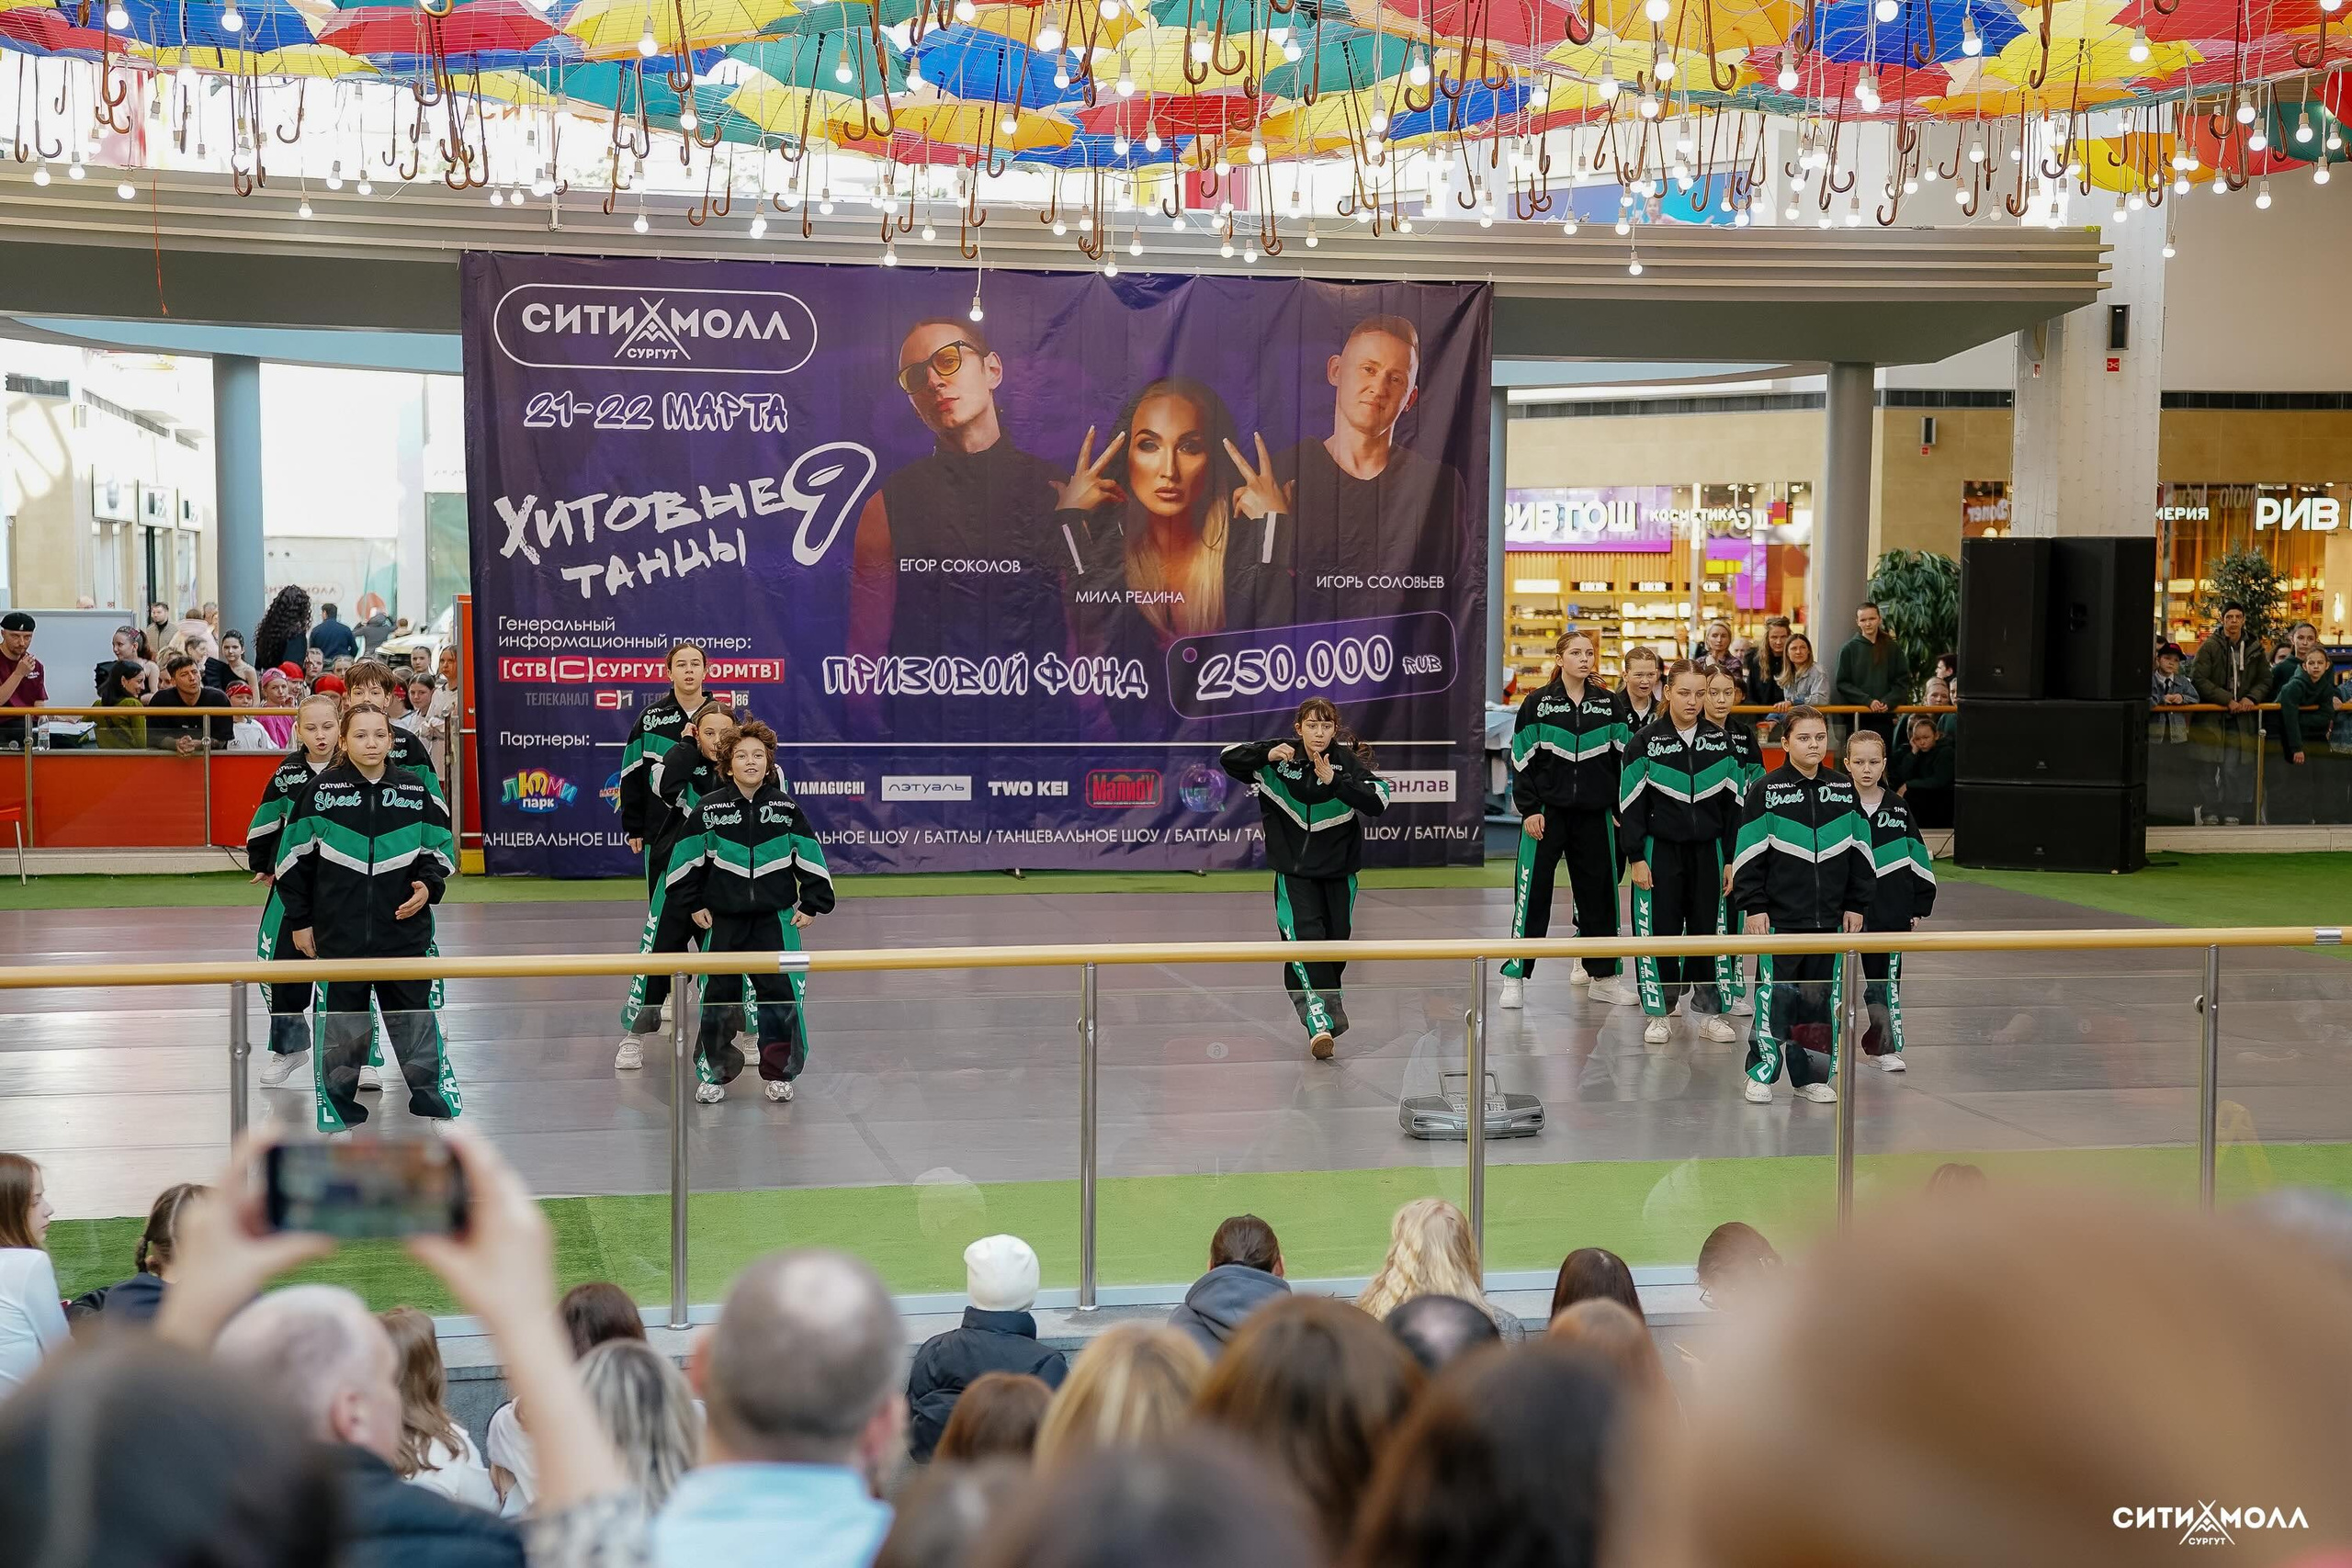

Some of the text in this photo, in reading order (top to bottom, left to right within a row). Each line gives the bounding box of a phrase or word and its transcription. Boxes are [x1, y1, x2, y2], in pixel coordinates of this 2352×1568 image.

[521, 303, 791, 340] СИТИ МОЛЛ
[627, 347, 678, 360] СУРГУТ
[524, 390, 788, 433] 21-22 МАРТА
[2155, 506, 2210, 521] МЕРИЯ
[2256, 497, 2341, 531] РИВ
[560, 528, 747, 598] ТАНЦЫ
[899, 558, 1022, 574] ЕГОР СОКОЛОВ
[1317, 575, 1445, 590] ИГОРЬ СОЛОВЬЕВ
[1075, 590, 1185, 605] МИЛА РЕДИНА
[498, 615, 616, 635] Генеральный
[498, 632, 668, 651] информационный
[821, 652, 1148, 699] ПРИЗОВОЙ ФОНД
[1196, 635, 1442, 701] 250.000 RUB
[526, 692, 589, 706] ТЕЛЕКАНАЛ
[1537, 702, 1571, 718] Street
[643, 711, 682, 731] Street
[500, 731, 590, 750] Партнеры:
[1647, 740, 1683, 757] Street
[393, 784, 424, 792] ASHING
[793, 781, 865, 795] YAMAGUCHI
[988, 781, 1069, 796] TWO KEI
[1388, 780, 1450, 793] анлав
[314, 790, 362, 811] Street
[522, 796, 555, 811] парк
[703, 801, 736, 812] CATWALK
[1765, 788, 1804, 809] Street
[482, 831, 603, 849] АНЦЕВАЛЬНОЕ
[869, 830, 909, 845] ШОУ
[924, 830, 981, 844] БАТТЛЫ
[996, 829, 1118, 844] ТАНЦЕВАЛЬНОЕ
[1122, 829, 1159, 843] ШОУ
[1175, 828, 1230, 842] БАТТЛЫ
[1364, 827, 1400, 840] ШОУ
[1415, 826, 1468, 840] БАТТЛЫ
